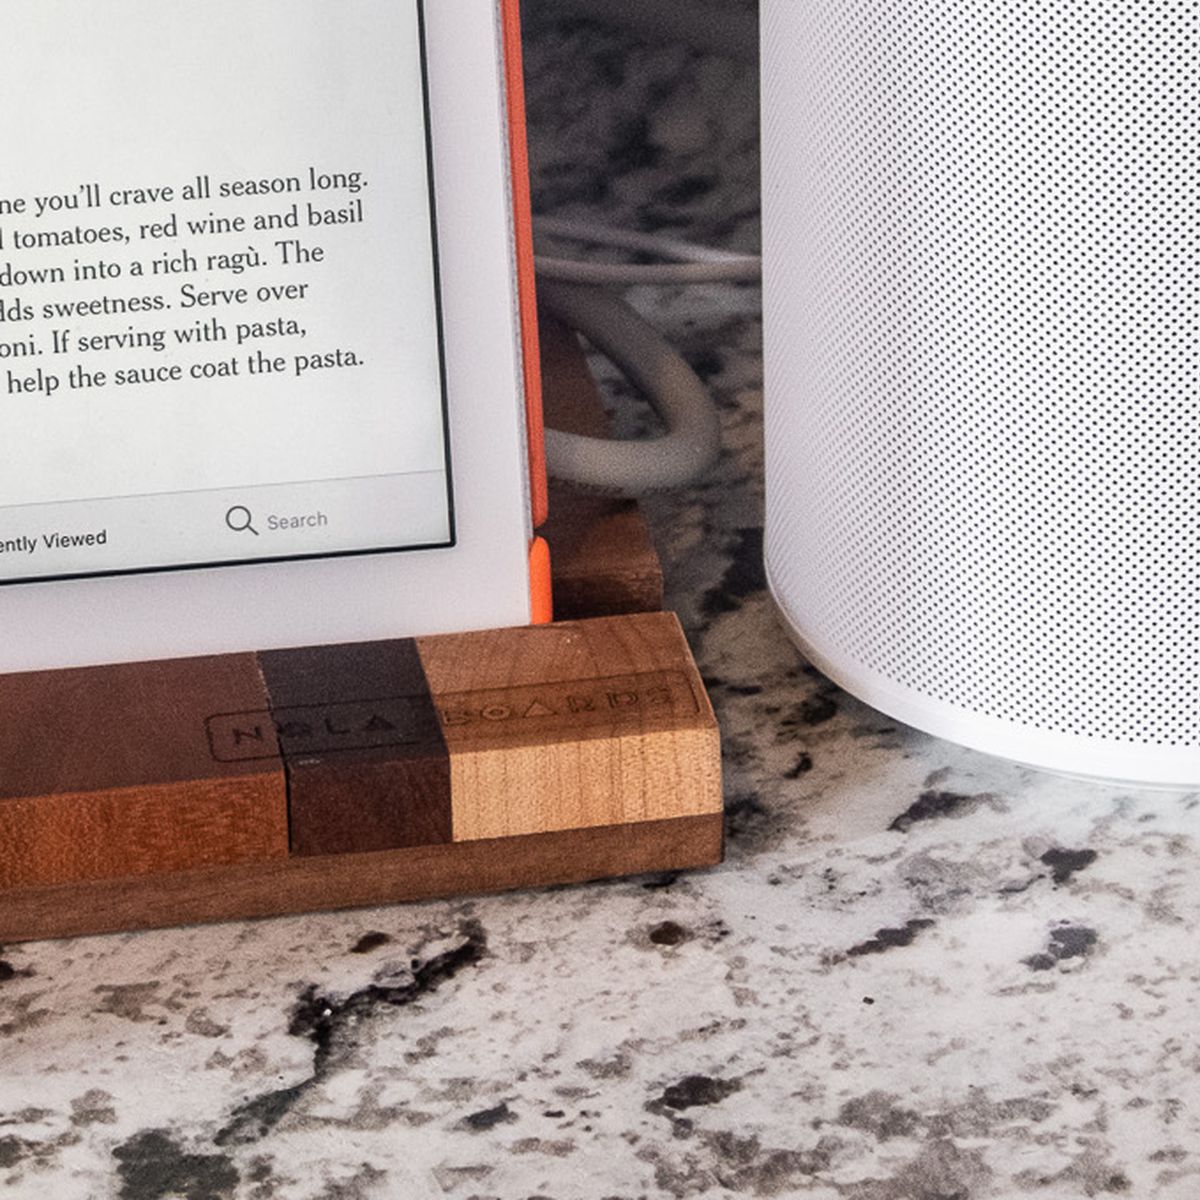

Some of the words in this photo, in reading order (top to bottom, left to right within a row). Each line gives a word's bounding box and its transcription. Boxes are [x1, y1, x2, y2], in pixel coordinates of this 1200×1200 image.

[34, 183, 101, 218] you’ll
[109, 186, 174, 206] crave
[182, 174, 211, 201] all
[219, 177, 302, 198] season
[309, 166, 368, 192] long.
[13, 225, 131, 250] tomatoes,
[139, 212, 178, 240] red
[186, 212, 246, 235] wine
[253, 203, 299, 231] and
[306, 198, 363, 227] basil
[0, 262, 65, 287] down
[74, 258, 122, 281] into
[129, 261, 144, 277] a
[152, 248, 198, 275] rich
[207, 245, 268, 275] ragù.
[274, 239, 324, 265] The
[42, 295, 172, 319] sweetness.
[180, 283, 248, 309] Serve
[256, 283, 309, 303] over
[0, 333, 43, 359] oni.
[52, 329, 71, 354] If
[77, 325, 166, 353] serving
[173, 317, 227, 344] with
[235, 318, 307, 345] pasta,
[6, 367, 60, 397] help
[68, 364, 107, 390] the
[114, 365, 183, 386] sauce
[189, 357, 240, 379] coat
[247, 349, 286, 375] the
[294, 348, 364, 377] pasta.
[42, 529, 107, 549] Viewed
[266, 511, 328, 531] Search
